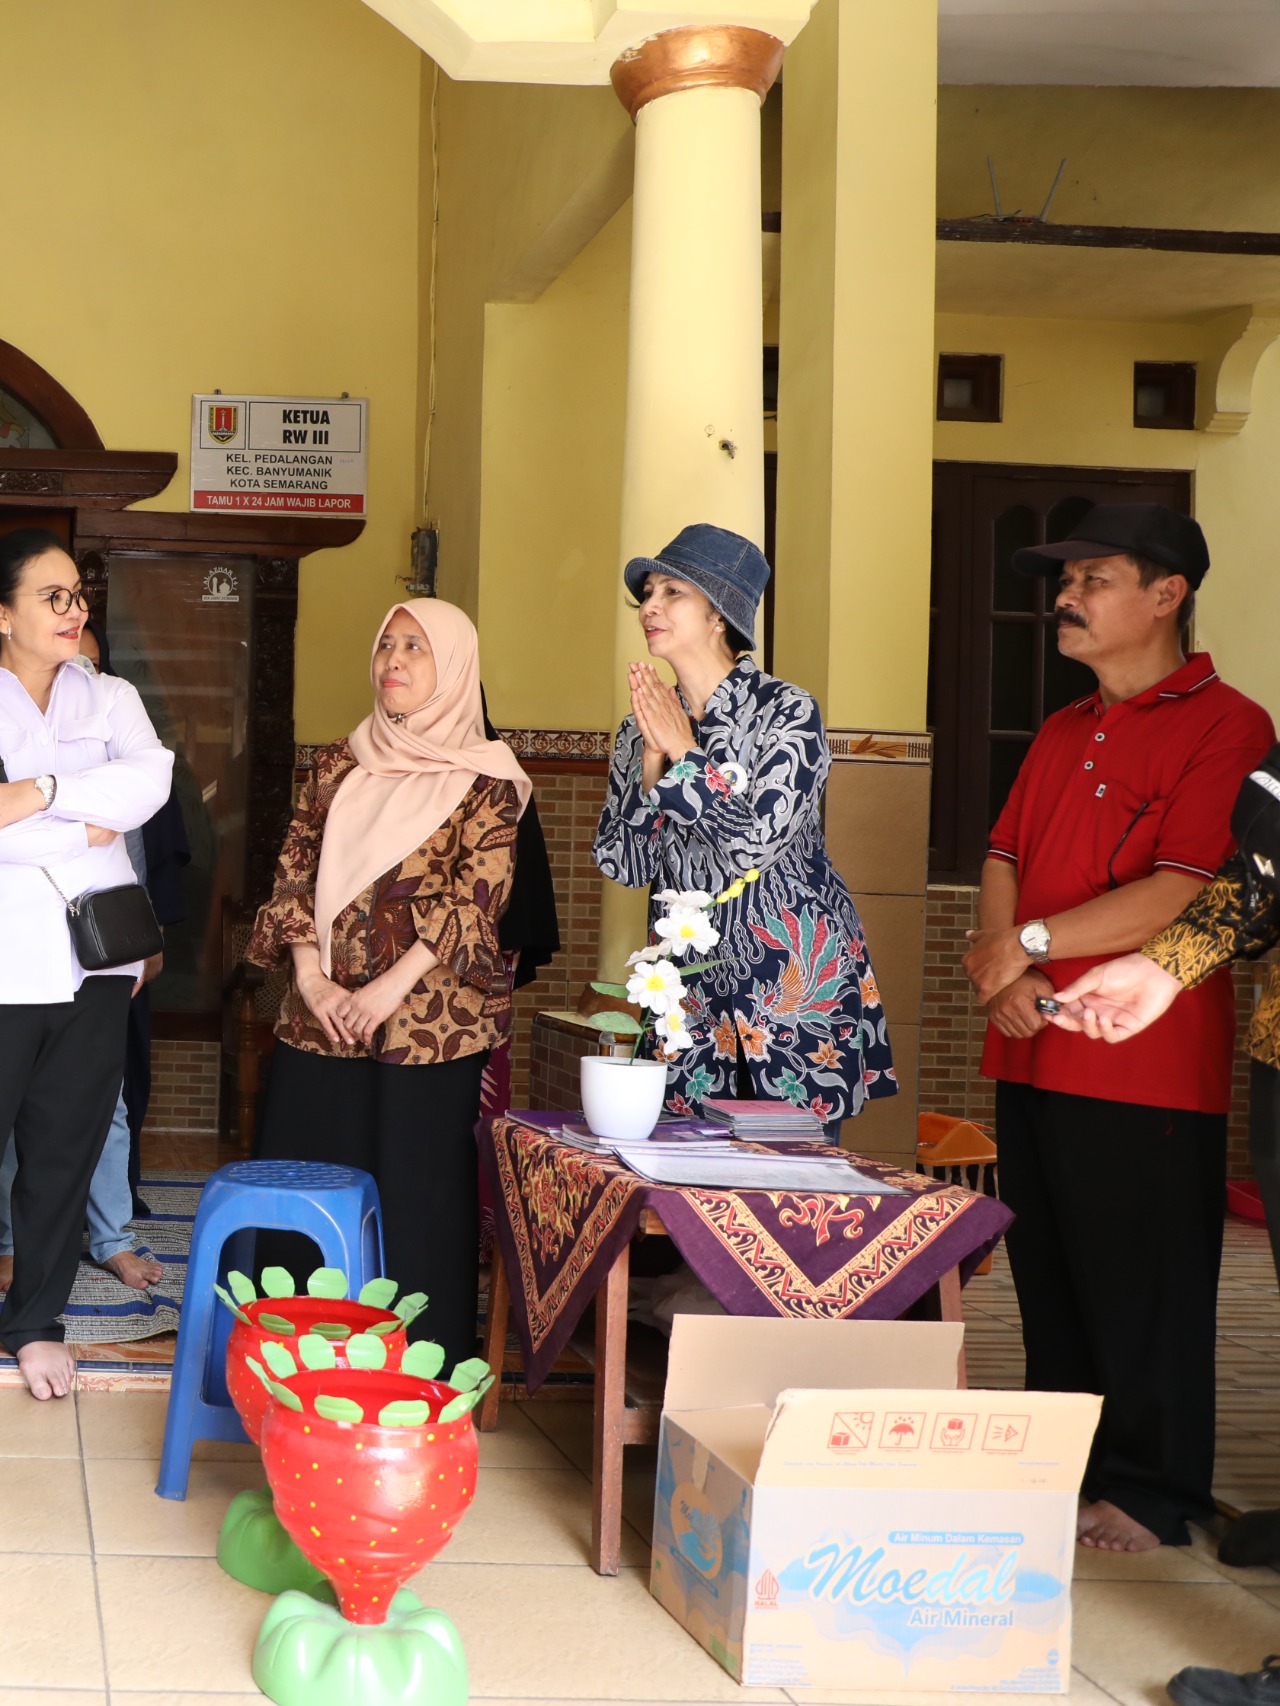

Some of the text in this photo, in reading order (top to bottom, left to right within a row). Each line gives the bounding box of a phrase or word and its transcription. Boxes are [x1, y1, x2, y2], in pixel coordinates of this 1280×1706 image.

[282, 409, 330, 424] KETUA
[282, 429, 329, 445] RW III
[226, 453, 251, 463] KEL.
[254, 454, 333, 465] PEDALANGAN
[226, 466, 332, 478] KEC. BANYUMANIK
[230, 478, 328, 490] KOTA SEMARANG
[207, 495, 351, 509] TAMU 1 X 24 JAM WAJIB LAPOR
[894, 1533, 1022, 1545] Air Minum Dalam Kemasan
[807, 1541, 1018, 1602] Moedal
[910, 1609, 1013, 1627] Air Mineral
